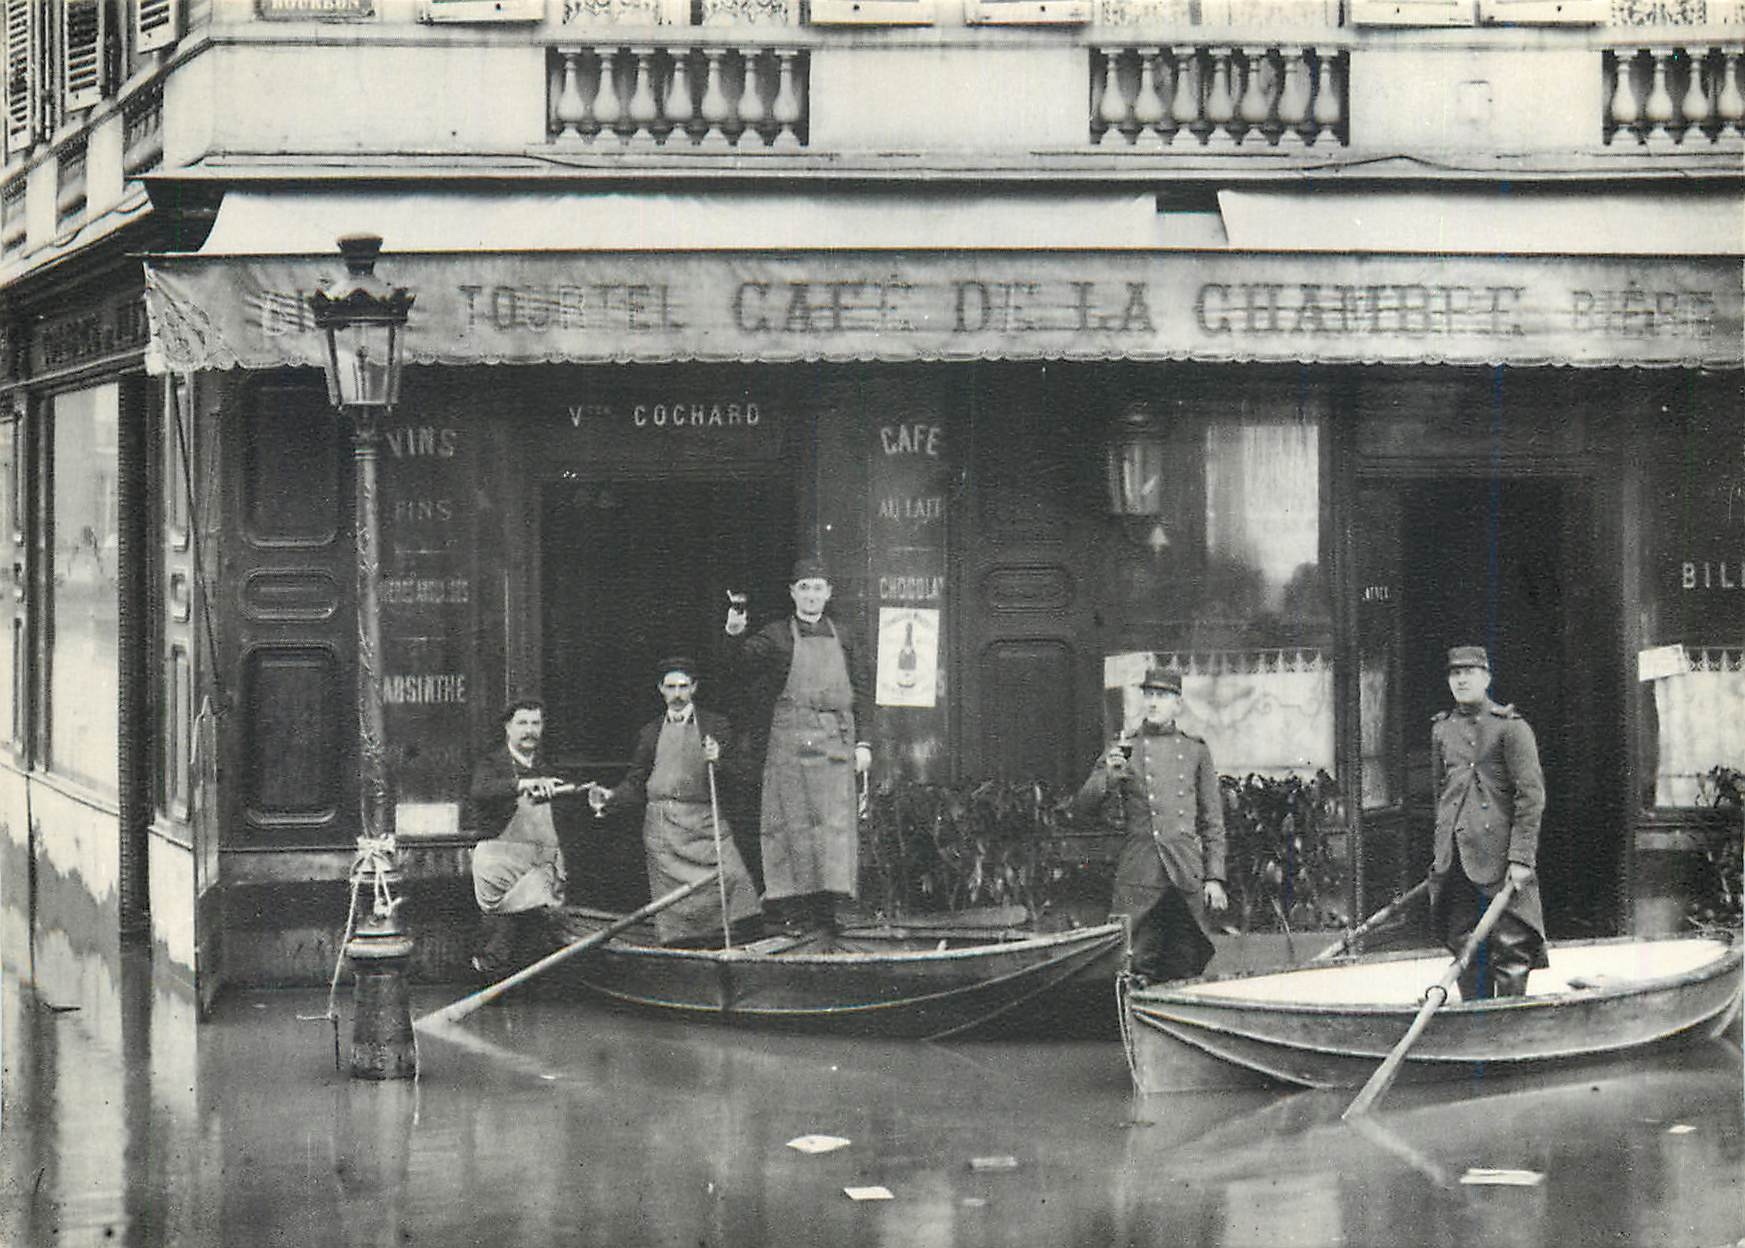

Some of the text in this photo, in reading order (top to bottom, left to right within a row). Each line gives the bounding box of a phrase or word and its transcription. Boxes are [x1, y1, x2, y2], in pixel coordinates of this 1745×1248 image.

[952, 281, 1041, 333] DE
[1066, 282, 1157, 333] LA
[1196, 282, 1527, 336] CHAMBRE
[633, 403, 760, 426] COCHARD
[386, 427, 456, 457] VINS
[1682, 561, 1745, 588] BIL
[383, 674, 467, 704] ABSINTHE
